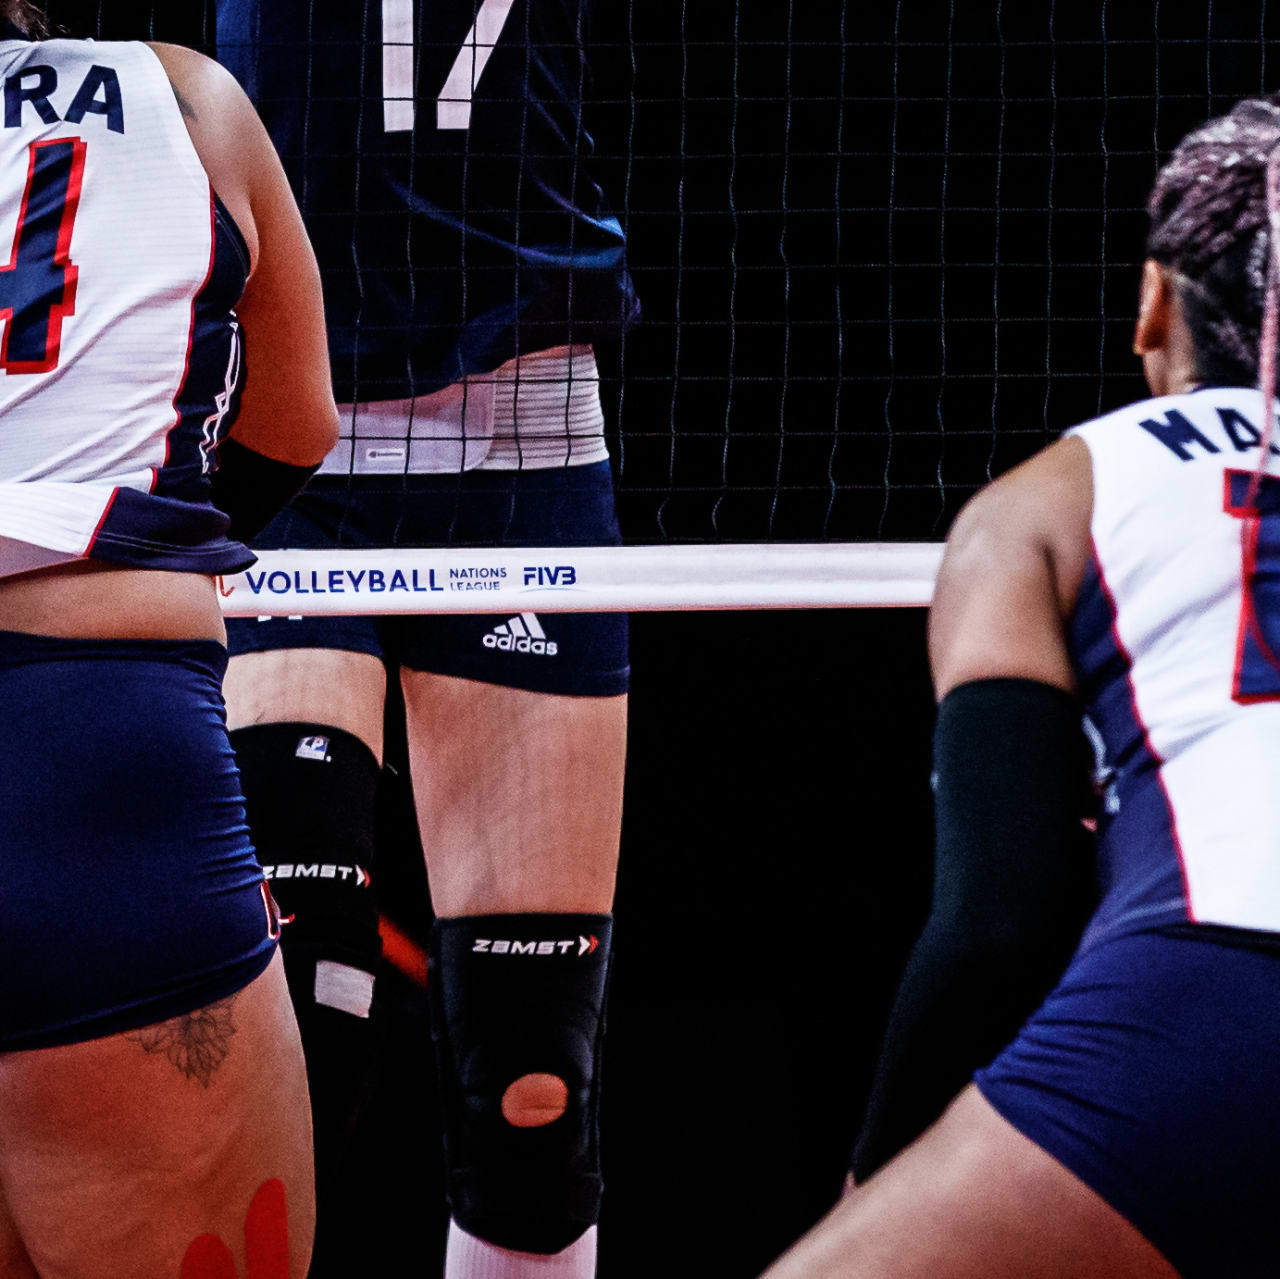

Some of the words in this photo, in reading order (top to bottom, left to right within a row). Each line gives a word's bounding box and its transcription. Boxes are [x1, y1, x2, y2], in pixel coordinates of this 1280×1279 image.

[245, 568, 444, 595] VOLLEYBALL
[449, 567, 508, 579] NATIONS
[523, 566, 577, 586] FIVB
[450, 581, 501, 591] LEAGUE
[482, 633, 558, 656] adidas
